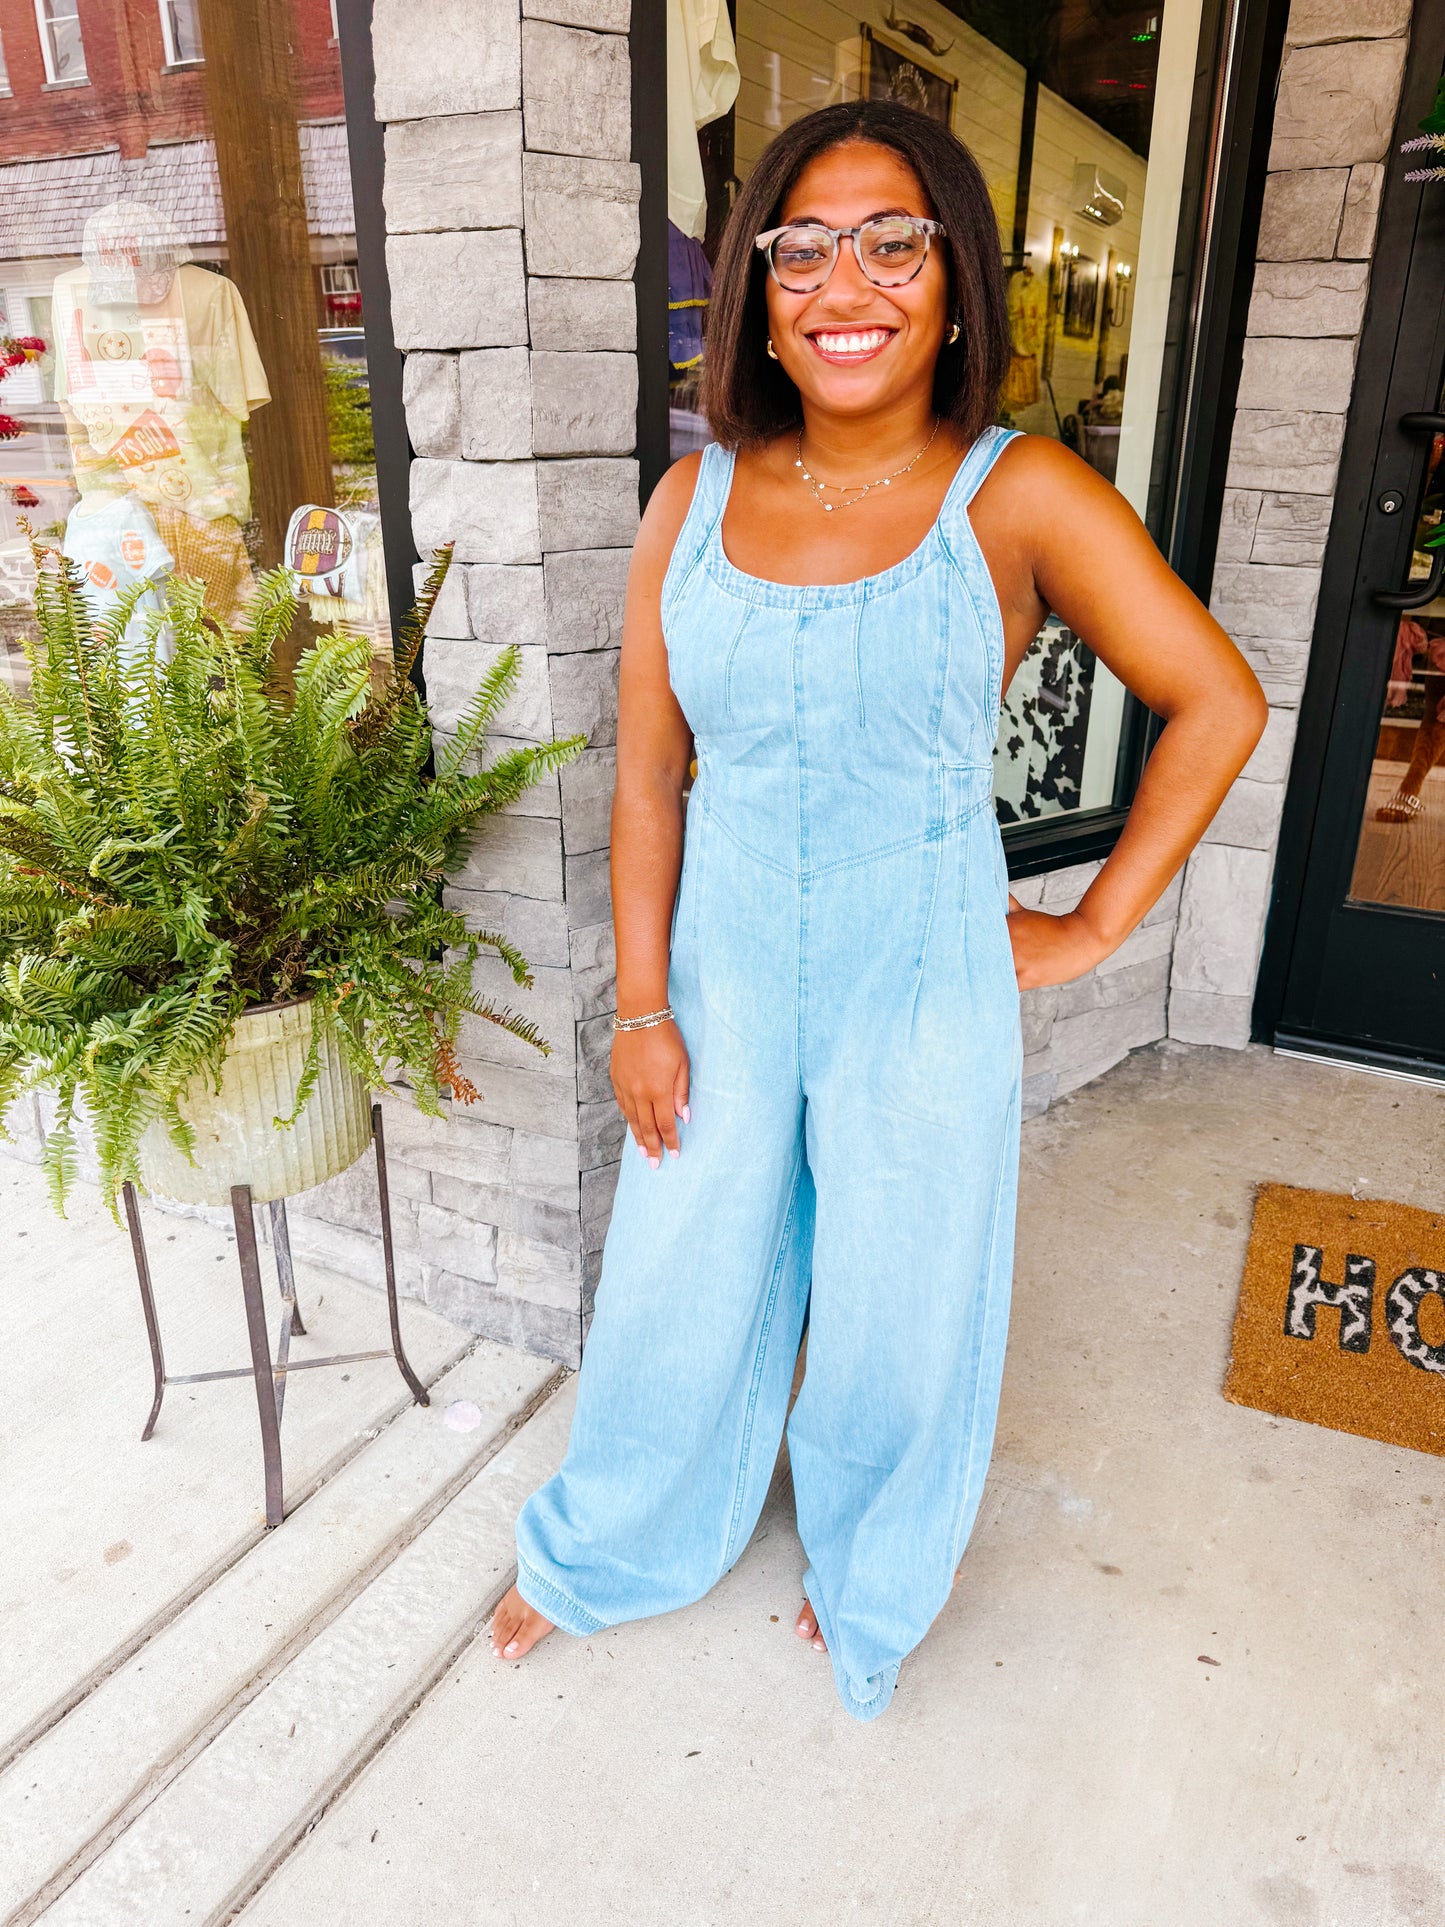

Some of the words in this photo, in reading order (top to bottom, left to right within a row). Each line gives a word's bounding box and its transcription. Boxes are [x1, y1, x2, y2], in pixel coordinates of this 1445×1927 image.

[98, 255, 121, 267] LOVE
[125, 255, 142, 267] ME
[120, 246, 140, 257] YOU
[134, 418, 172, 456] GO!
[1284, 1243, 1445, 1373] HO
